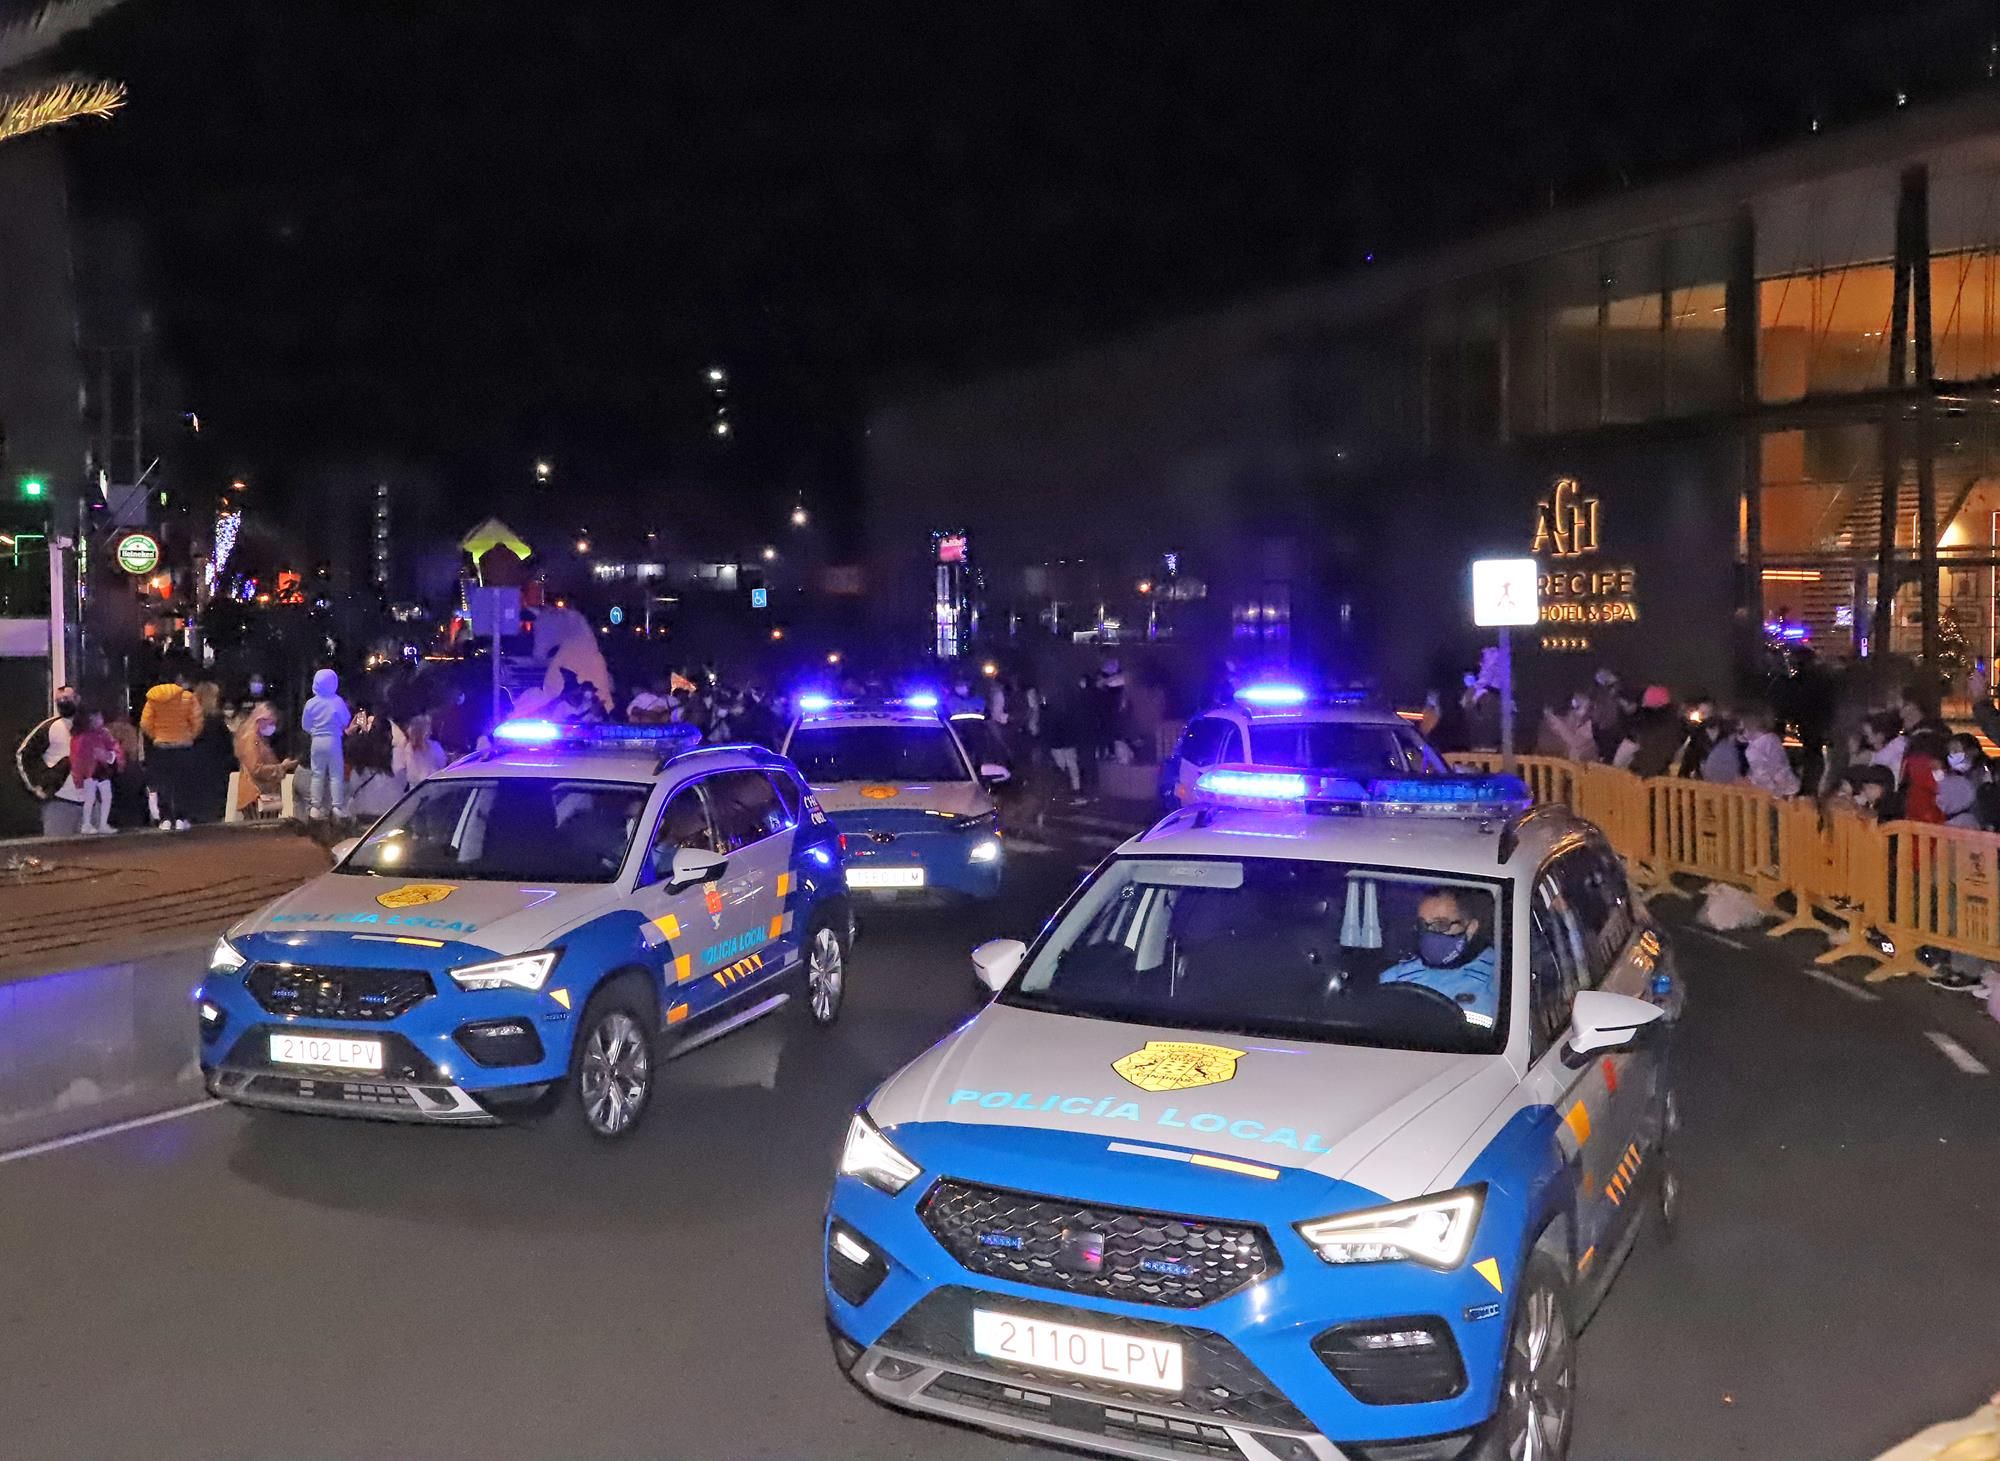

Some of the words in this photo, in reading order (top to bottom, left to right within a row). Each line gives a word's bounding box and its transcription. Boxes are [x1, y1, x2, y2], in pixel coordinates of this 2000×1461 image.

[1537, 570, 1636, 598] RECIFE
[1540, 603, 1587, 622] HOTEL
[1588, 605, 1601, 621] &
[1602, 602, 1638, 622] SPA
[385, 914, 480, 934] LOCAL
[283, 1039, 332, 1062] 2102
[338, 1043, 376, 1064] LPV
[949, 1088, 1140, 1121] POLICÍA
[1157, 1107, 1332, 1154] LOCAL
[999, 1320, 1087, 1366] 2110
[1100, 1337, 1170, 1380] LPV
